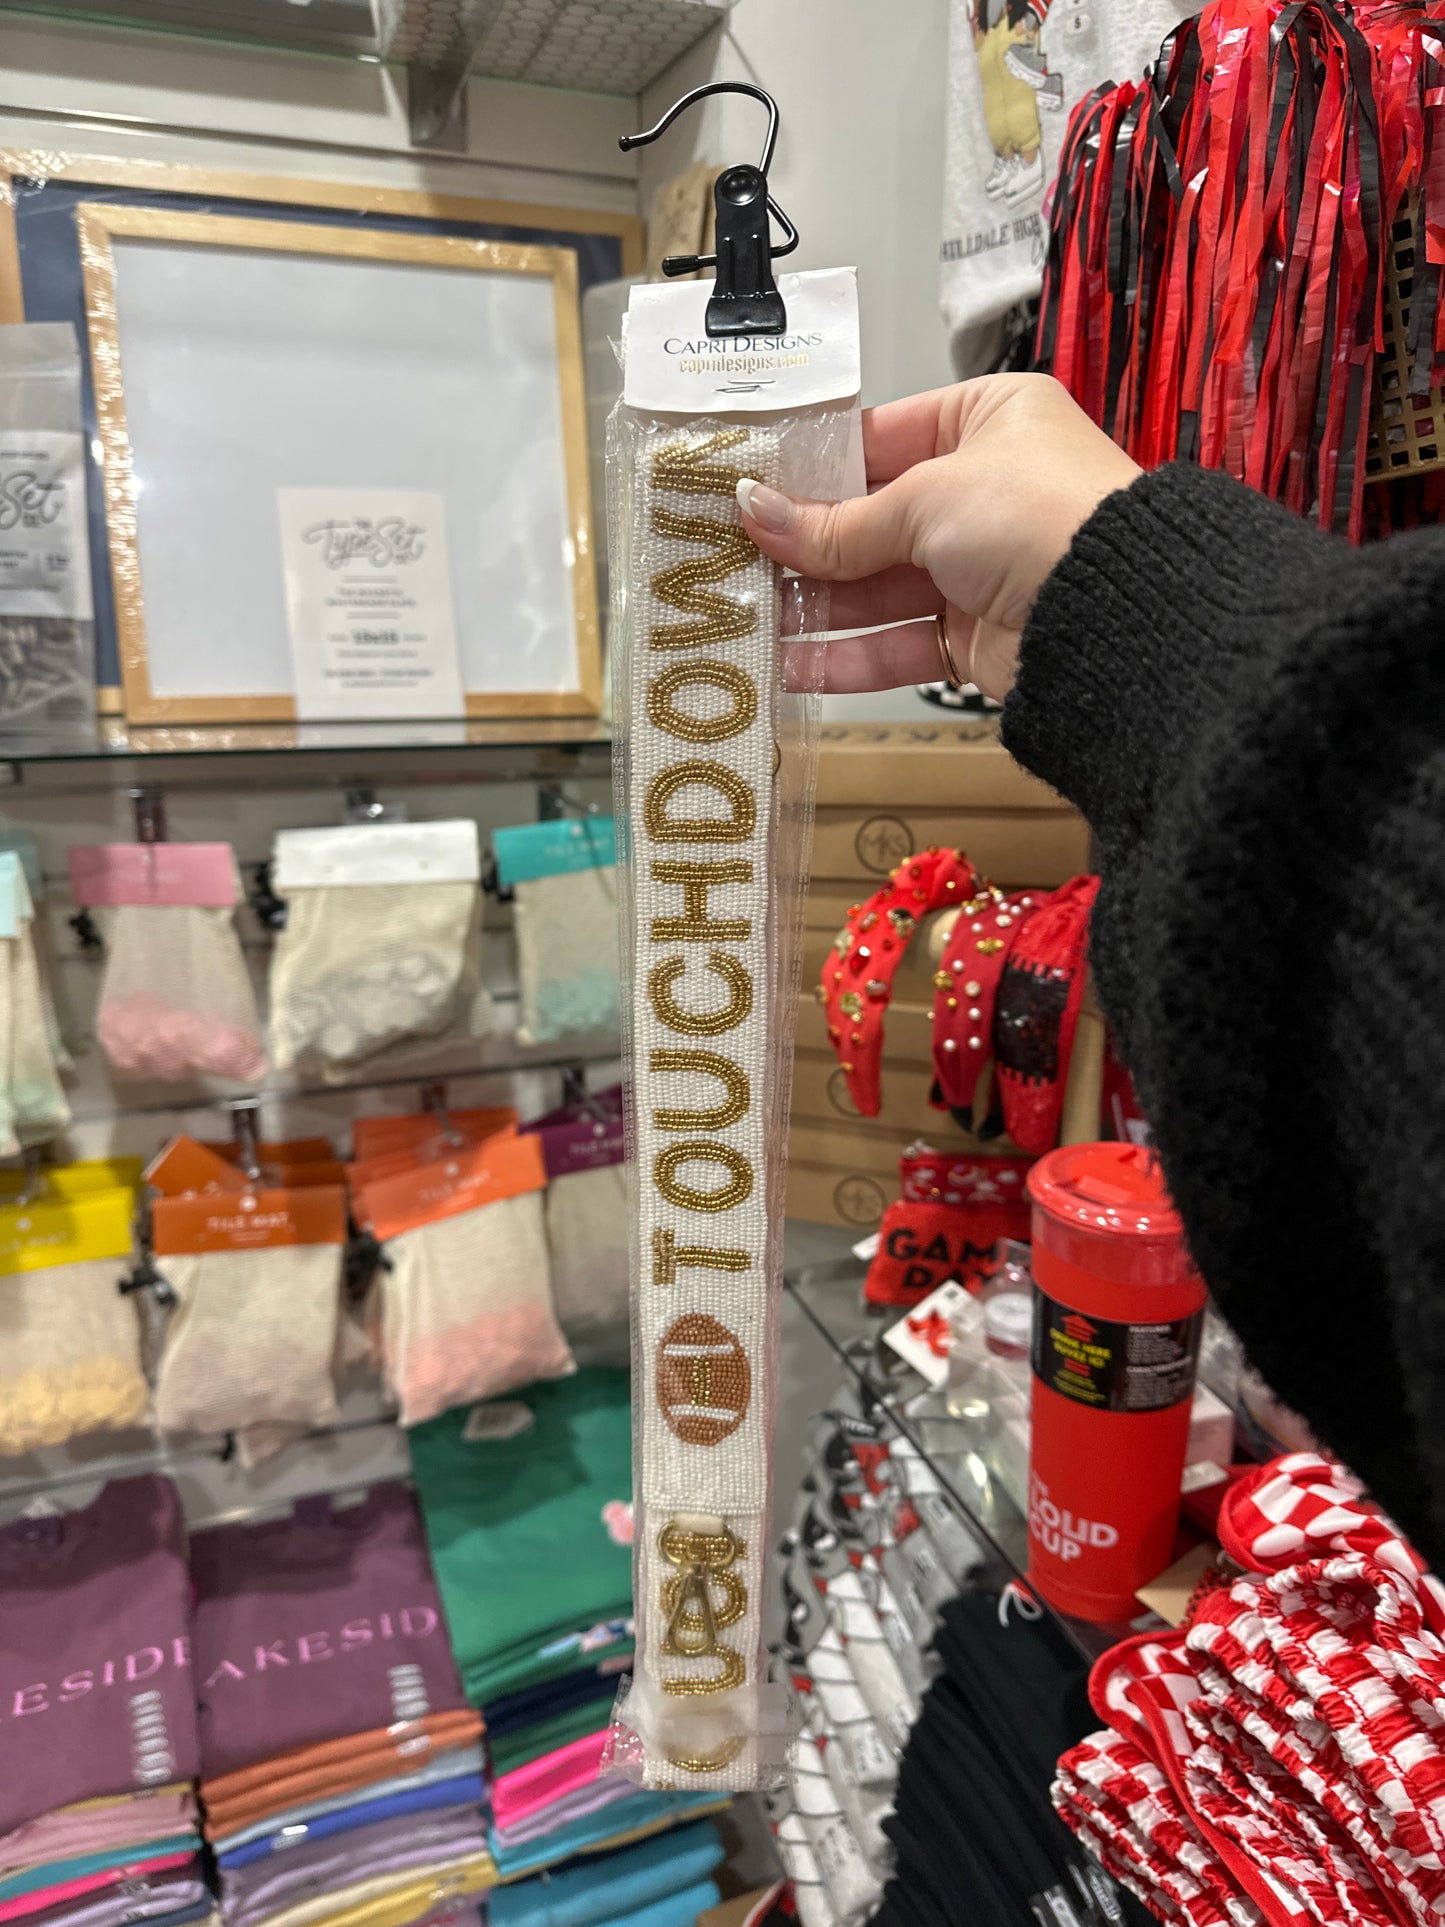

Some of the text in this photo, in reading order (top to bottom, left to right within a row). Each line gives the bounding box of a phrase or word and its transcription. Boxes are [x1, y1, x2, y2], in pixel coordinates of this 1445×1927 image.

[663, 331, 823, 355] CAPRI DESIGNS
[679, 352, 810, 375] capridesigns.com
[644, 429, 764, 1287] TOUCHDOWN
[885, 1228, 998, 1265] GAM
[1030, 1511, 1082, 1562] CUP
